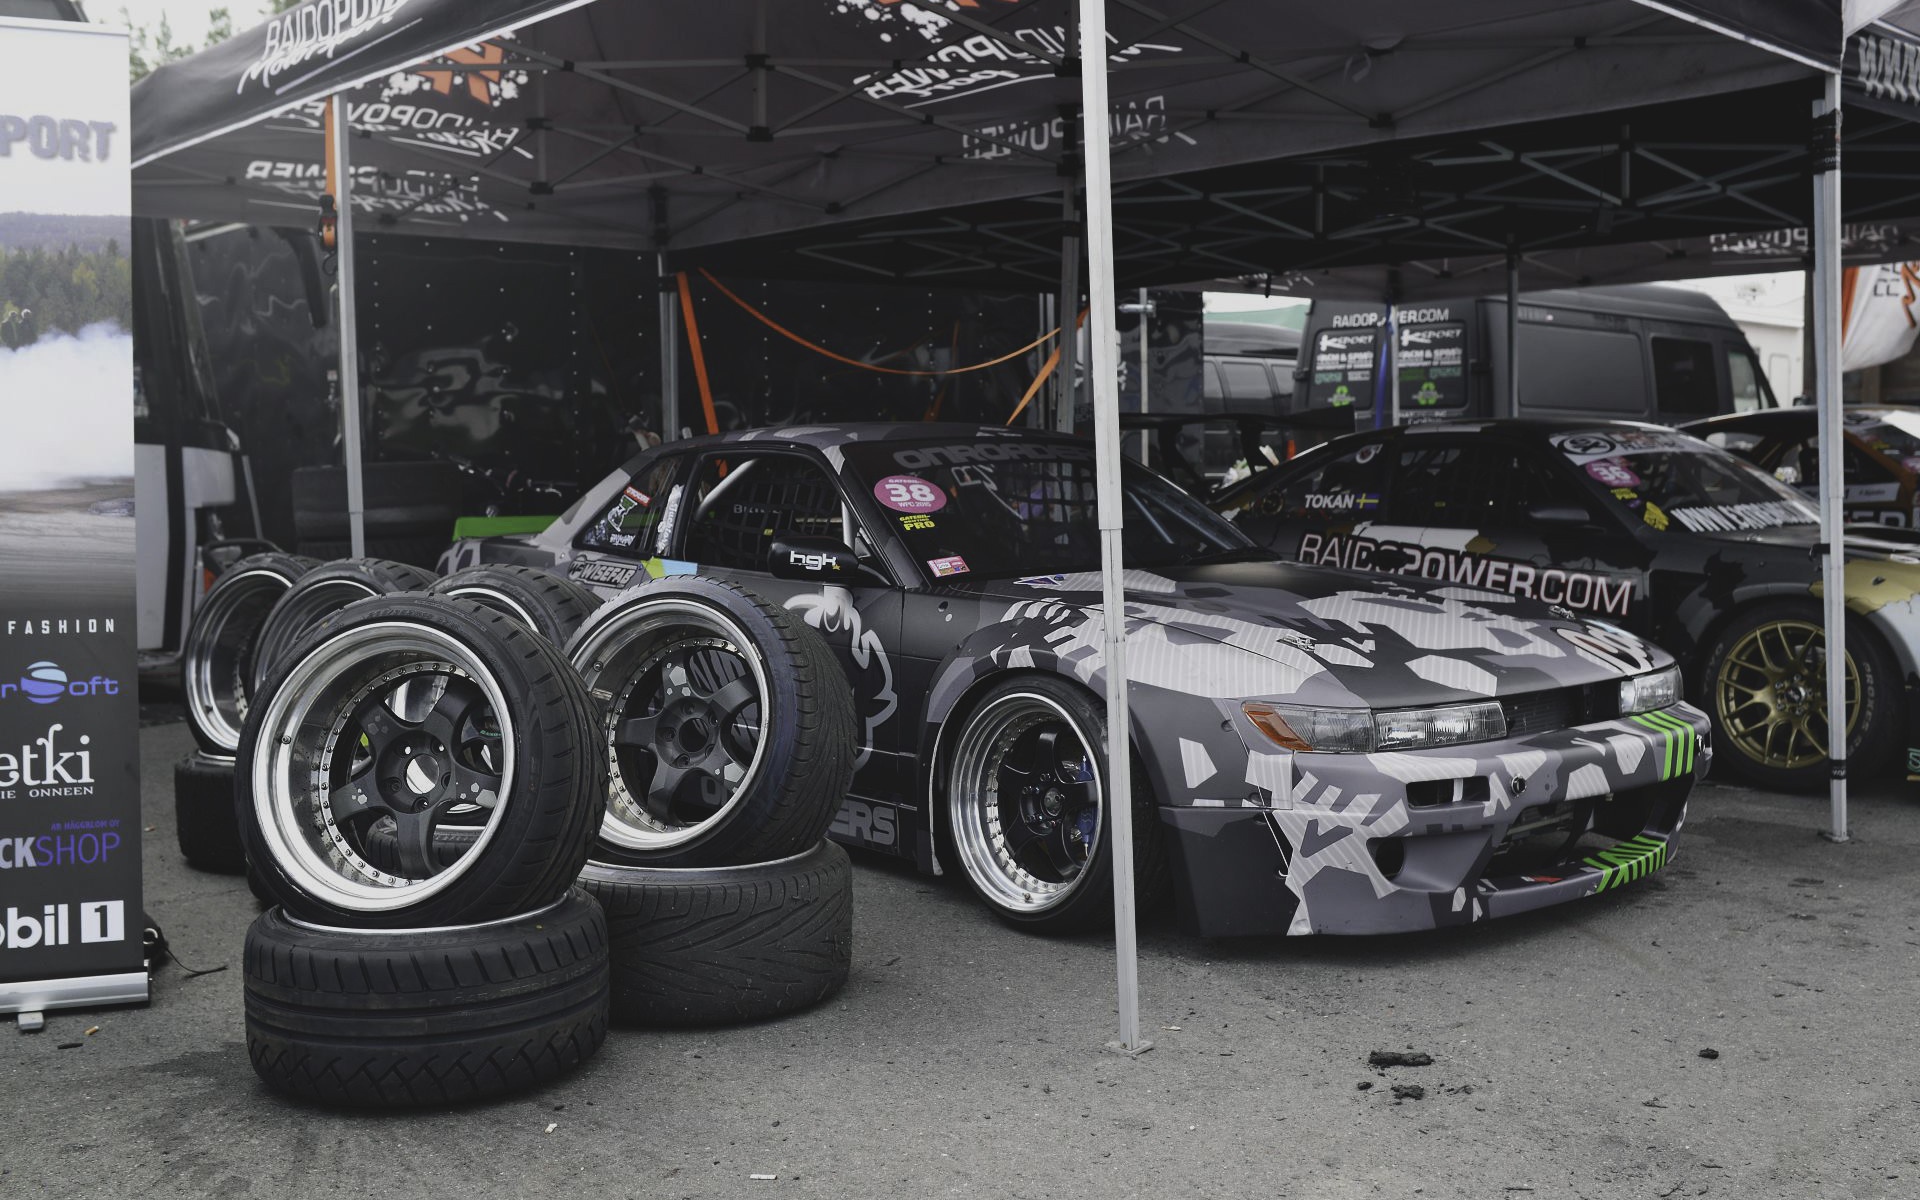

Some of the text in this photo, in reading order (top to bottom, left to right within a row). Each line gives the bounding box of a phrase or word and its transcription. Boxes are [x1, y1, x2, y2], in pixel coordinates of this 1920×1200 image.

[885, 484, 935, 502] 38
[1305, 494, 1354, 508] TOKAN
[904, 522, 935, 531] PRO
[789, 551, 837, 571] hgk
[582, 563, 637, 584] WISEFAB
[7, 618, 115, 635] FASHION
[29, 786, 94, 798] ONNEEN
[0, 903, 69, 949] bil
